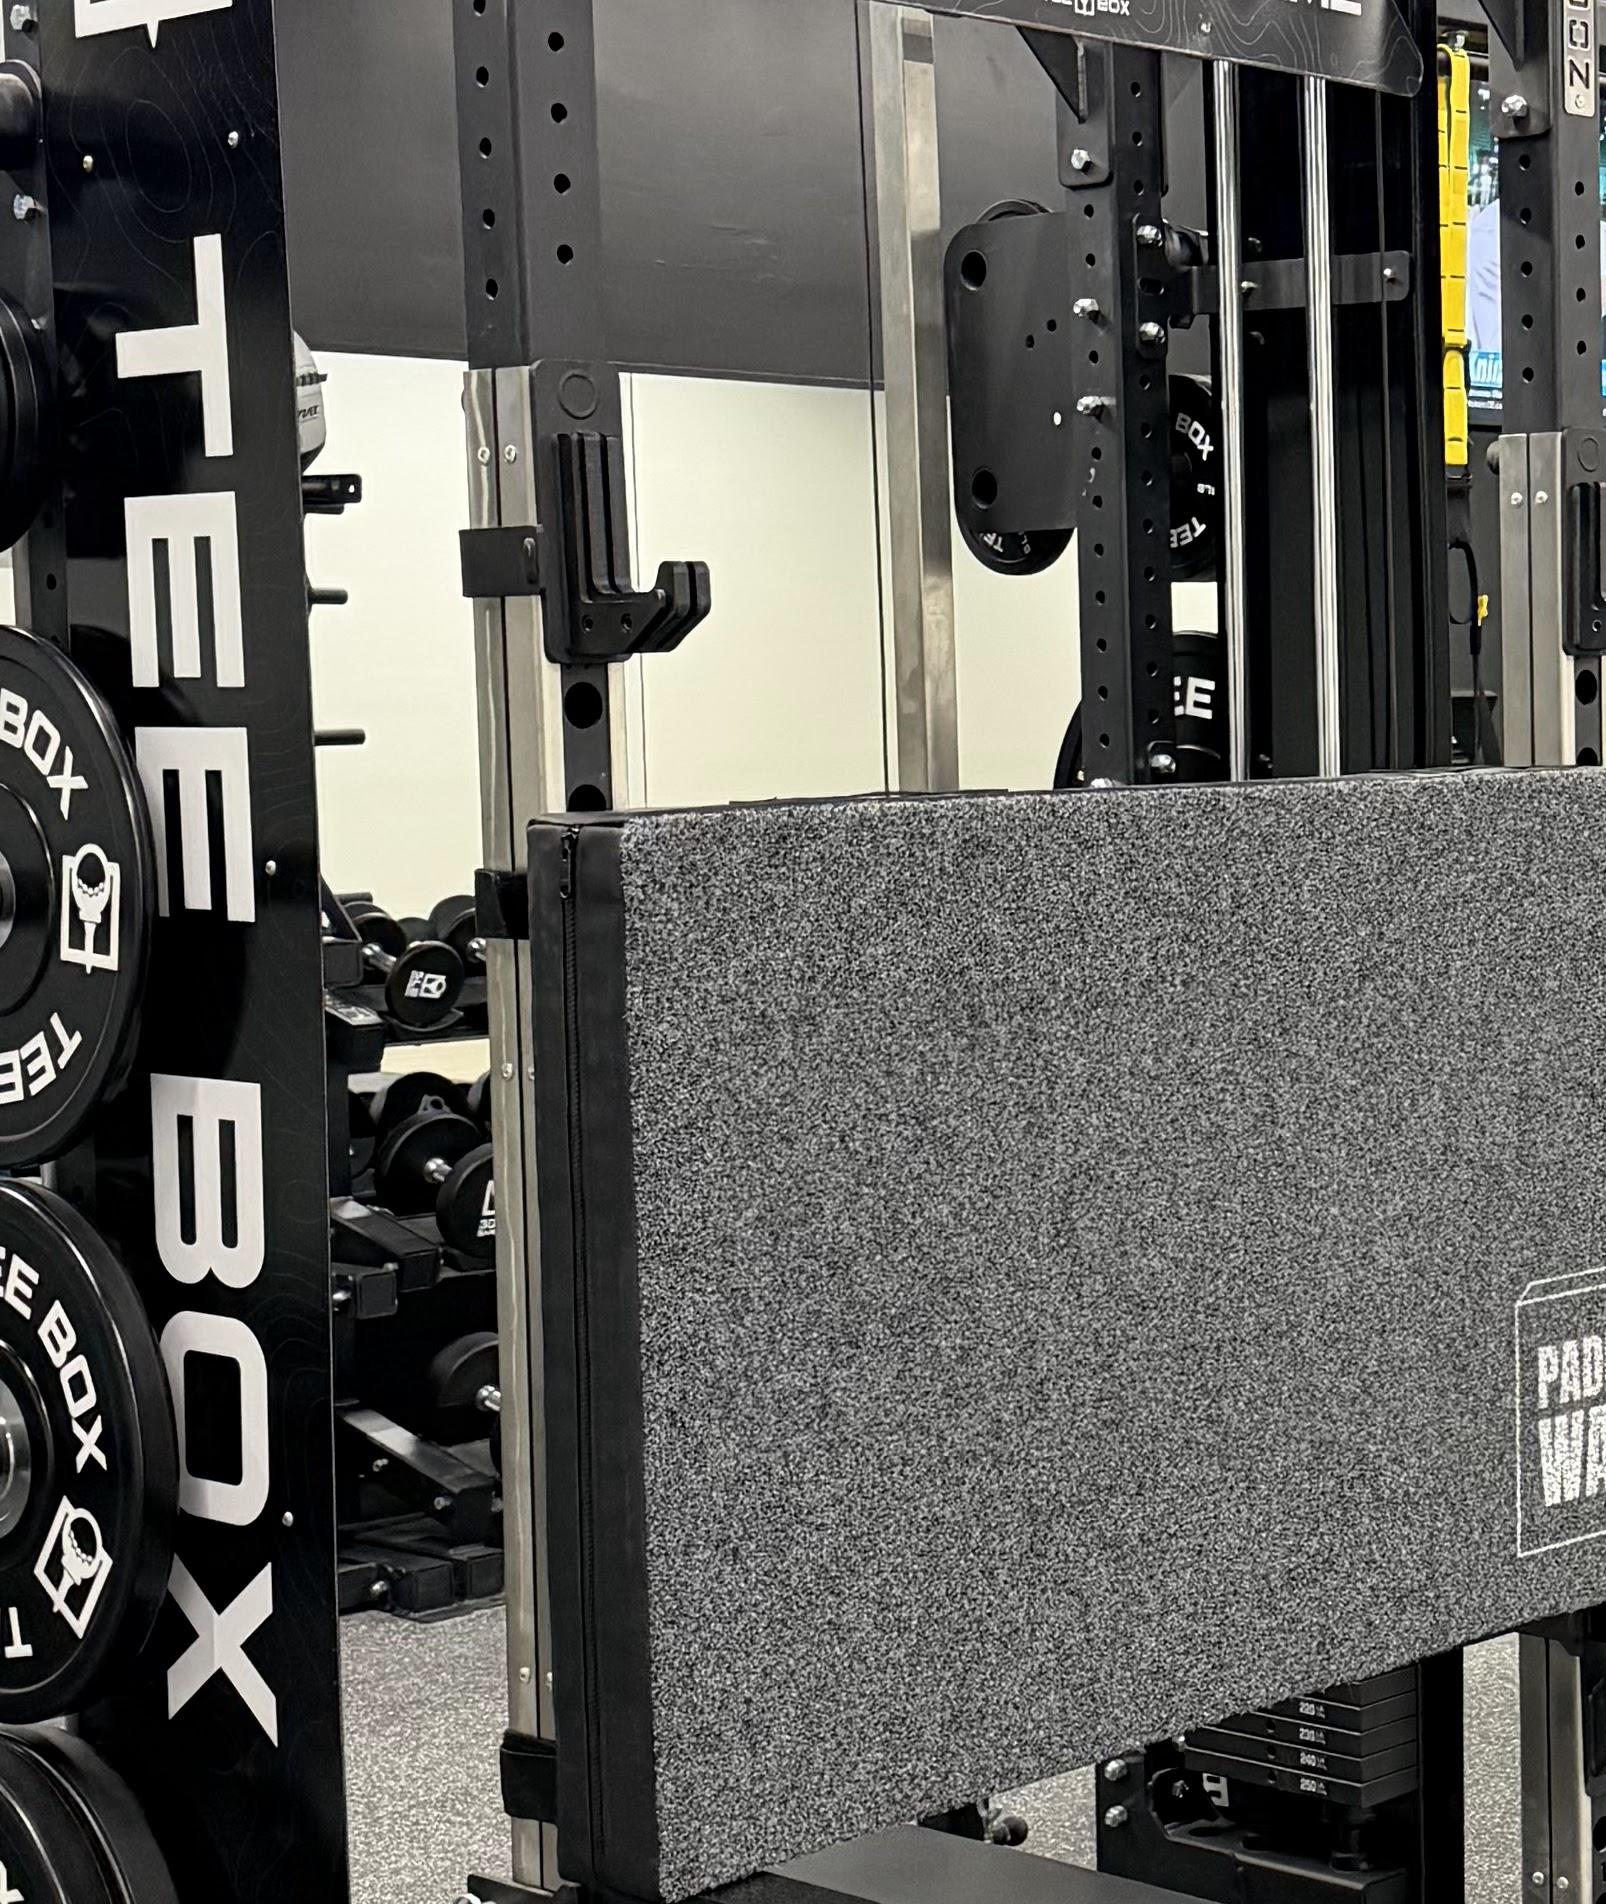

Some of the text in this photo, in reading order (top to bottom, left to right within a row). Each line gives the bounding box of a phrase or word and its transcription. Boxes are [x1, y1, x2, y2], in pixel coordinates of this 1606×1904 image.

[1175, 412, 1214, 462] BOX
[0, 688, 89, 821] BOX
[115, 232, 281, 1749] TEE BOX
[36, 1299, 108, 1475] BOX
